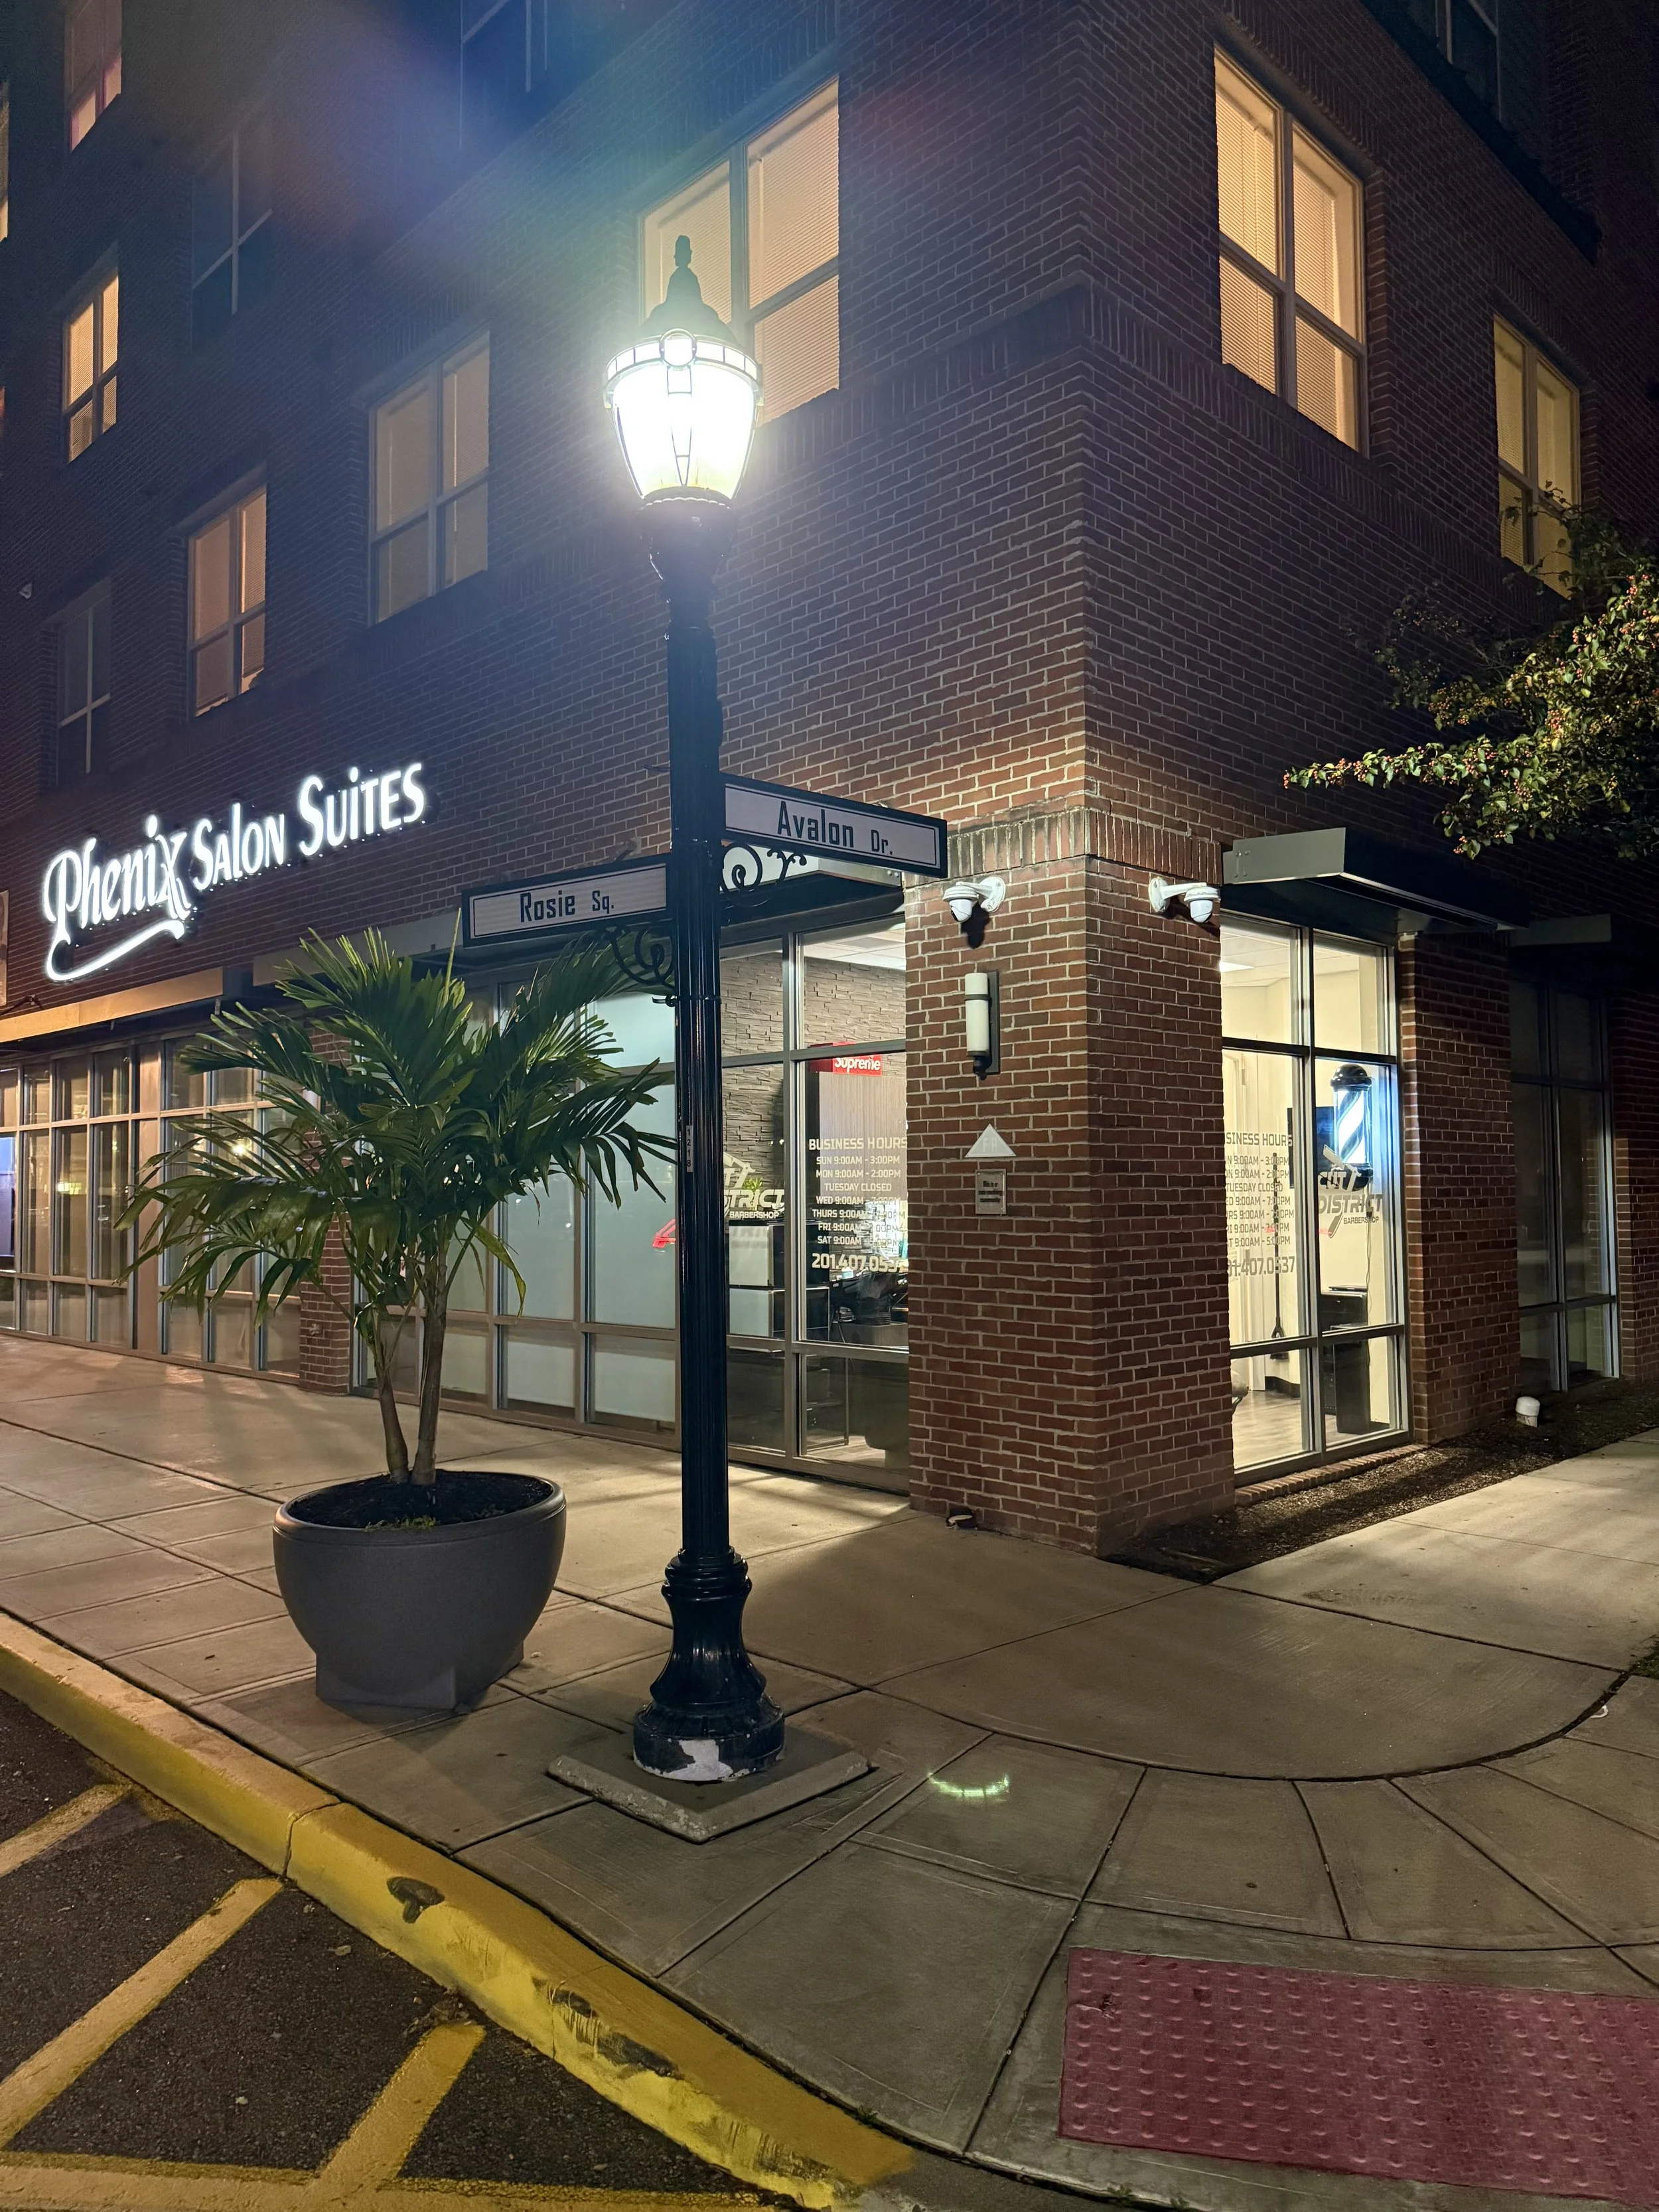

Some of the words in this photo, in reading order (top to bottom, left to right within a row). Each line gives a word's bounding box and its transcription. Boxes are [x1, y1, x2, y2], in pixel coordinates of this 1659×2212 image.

[778, 800, 854, 848] Avalon
[871, 830, 893, 855] Dr.
[520, 890, 575, 922] Rosie
[592, 890, 614, 914] Sq.
[834, 1057, 881, 1073] Supreme
[809, 1138, 864, 1150] BUSINESS
[868, 1137, 907, 1149] HOURS
[1226, 1132, 1260, 1145] SINESS
[1262, 1134, 1293, 1147] HOURS
[816, 1156, 832, 1165] SUN
[834, 1156, 862, 1165] 9:00AM
[870, 1155, 900, 1164] 3:00PM
[1234, 1155, 1259, 1165] 9:00AM
[816, 1169, 833, 1178] MON
[835, 1169, 863, 1178] 9:00AM
[871, 1169, 901, 1178] 2:00PM
[1235, 1169, 1260, 1179] 9:00AM
[1226, 1183, 1256, 1192] TUESDAY
[1258, 1183, 1283, 1192] CLOSED
[816, 1196, 833, 1205] WED
[835, 1196, 864, 1205] 9:00AM
[1236, 1197, 1260, 1206] 9:00AM
[1267, 1196, 1290, 1205] 7:00PM
[812, 1209, 837, 1218] THURS
[1240, 1210, 1264, 1219] 9:00AM
[1344, 1216, 1379, 1224] BARBERSOP
[833, 1223, 861, 1232] 9:00AM
[1234, 1224, 1259, 1233] 9:00AM
[817, 1236, 831, 1244] SAT
[833, 1236, 861, 1245] 9:00AM
[1235, 1237, 1260, 1247] 9:00AM
[1266, 1236, 1290, 1245] 5:00PM
[1228, 1256, 1295, 1277] 01.407.0537
